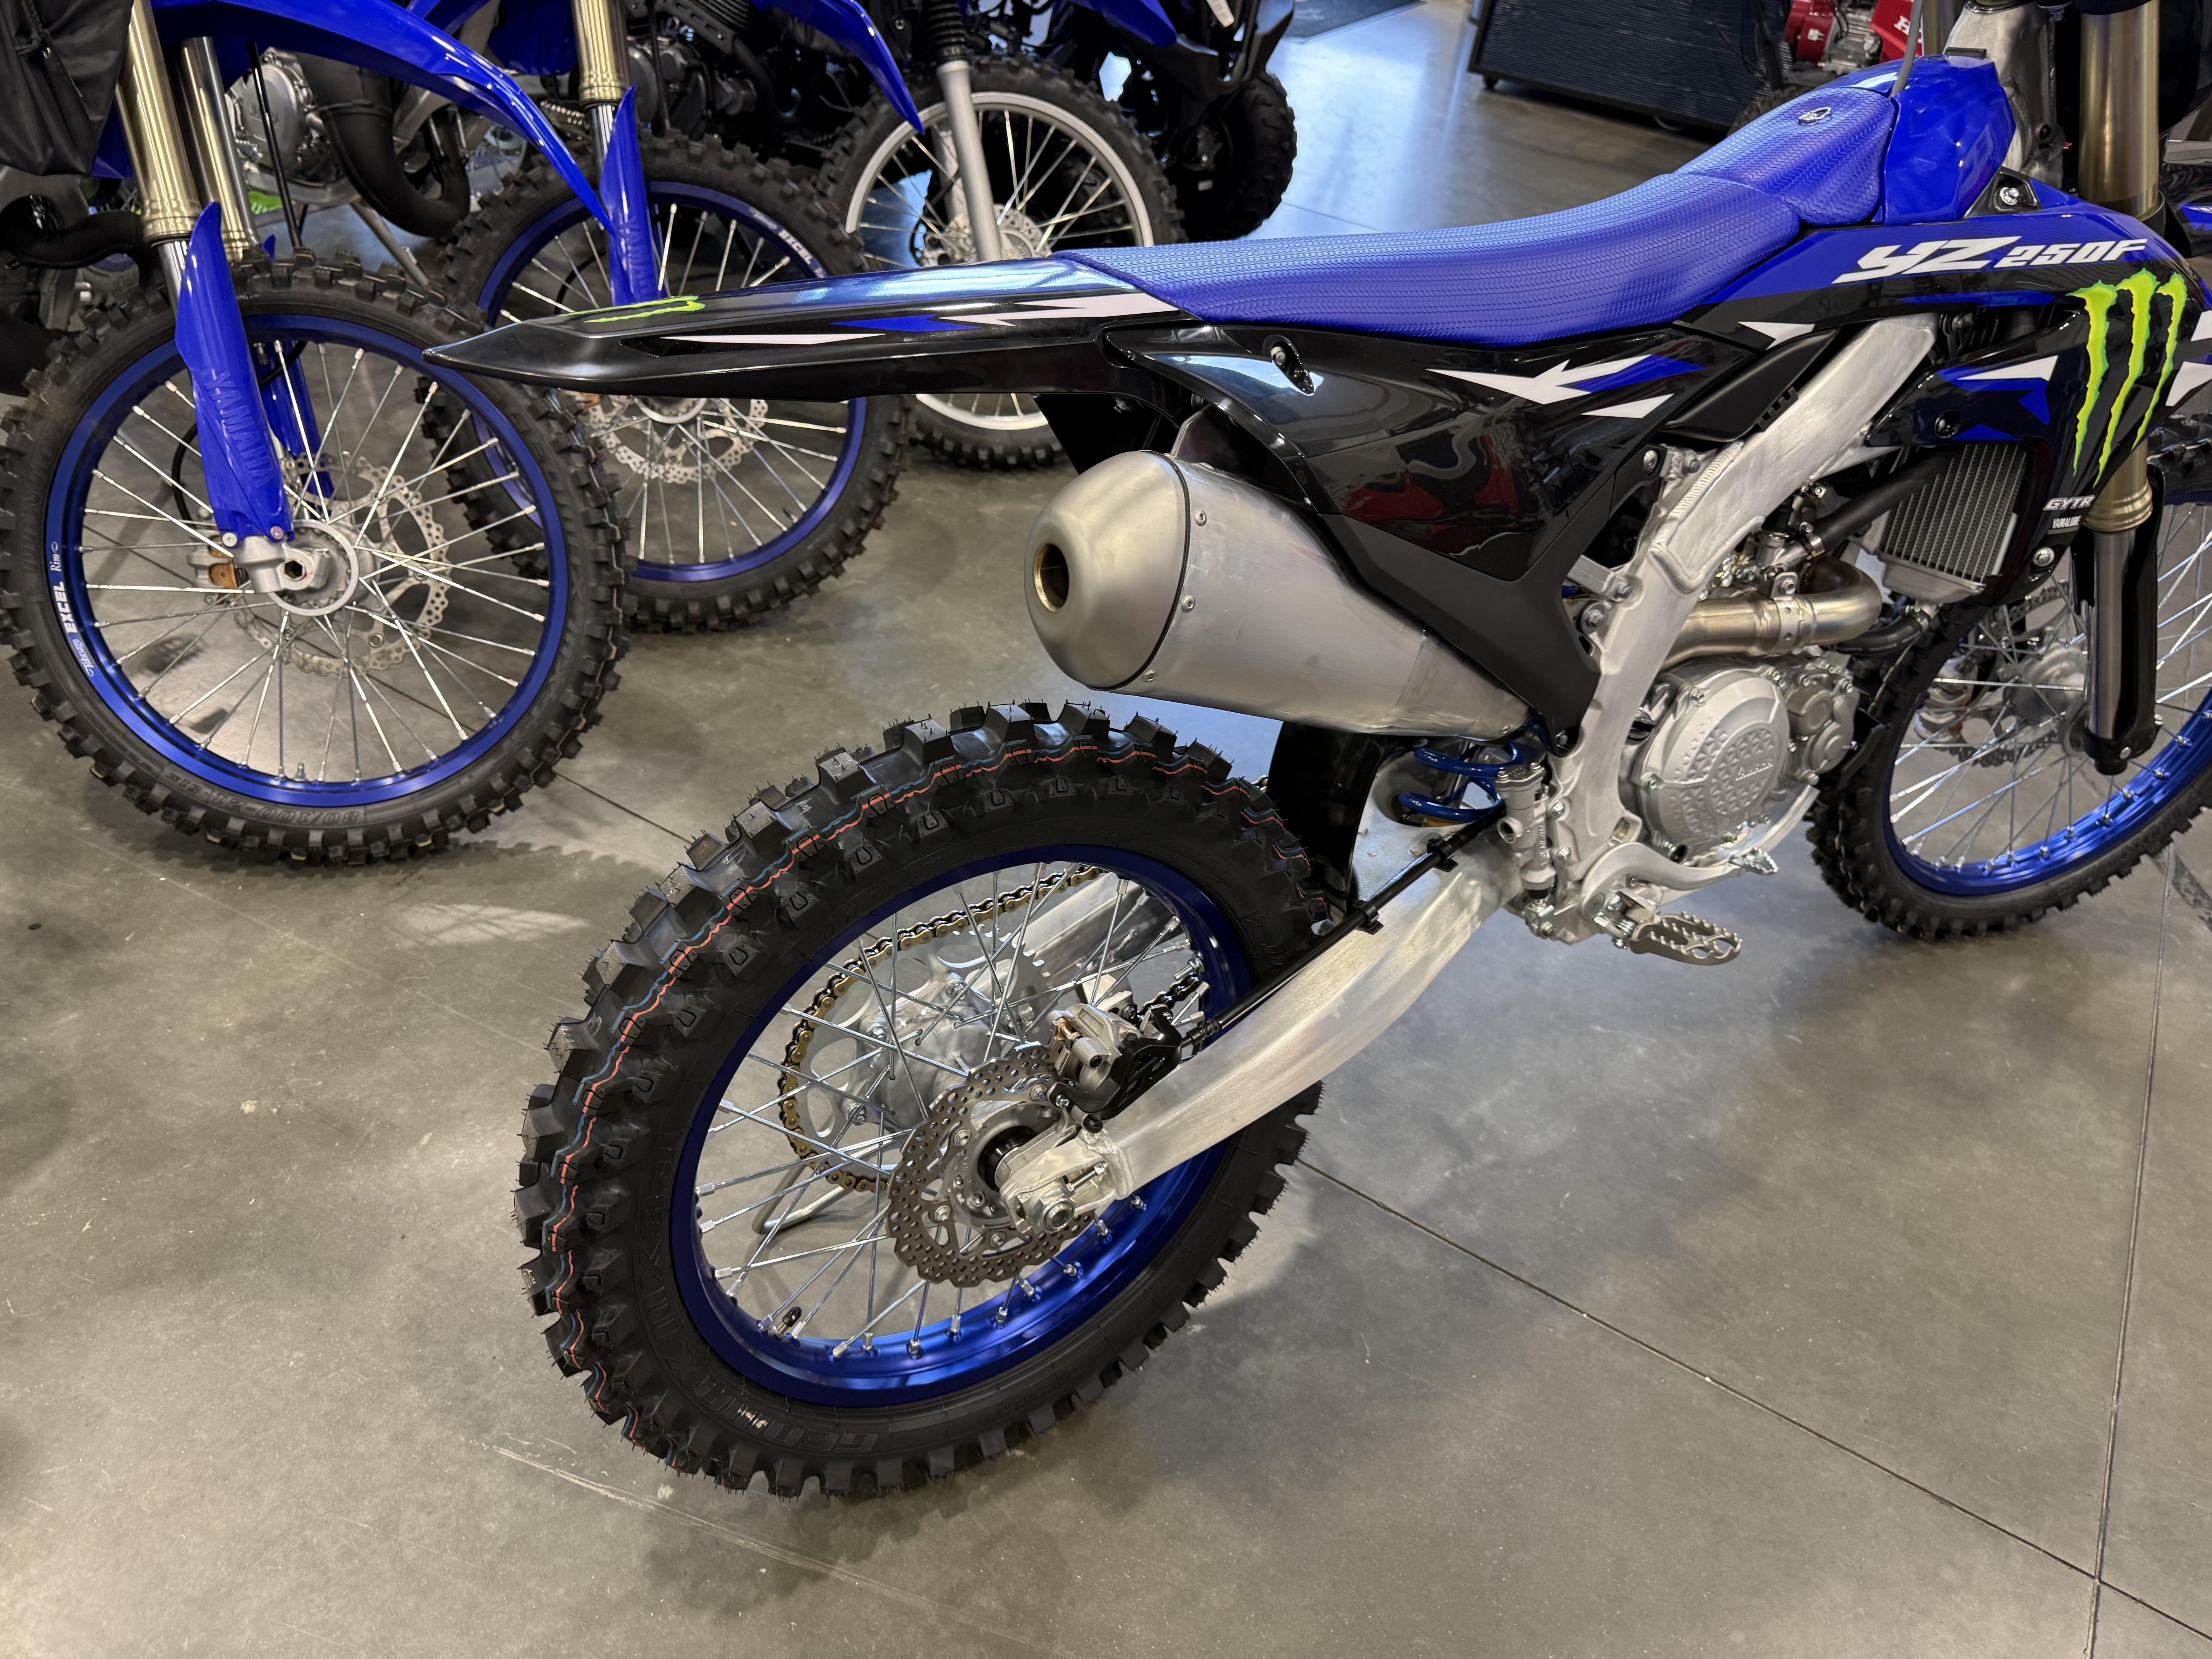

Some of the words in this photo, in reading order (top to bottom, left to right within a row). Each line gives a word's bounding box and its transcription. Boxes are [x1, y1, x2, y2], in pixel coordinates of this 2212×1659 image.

[778, 229, 812, 265] EXCEL
[1831, 236, 2022, 284] YZ
[1993, 239, 2147, 268] 250F
[205, 369, 273, 489] YAMAHA
[2043, 494, 2095, 510] GYTR
[2052, 515, 2082, 529] YAMALUBE
[49, 541, 62, 572] Rim
[53, 581, 77, 634] EXCEL
